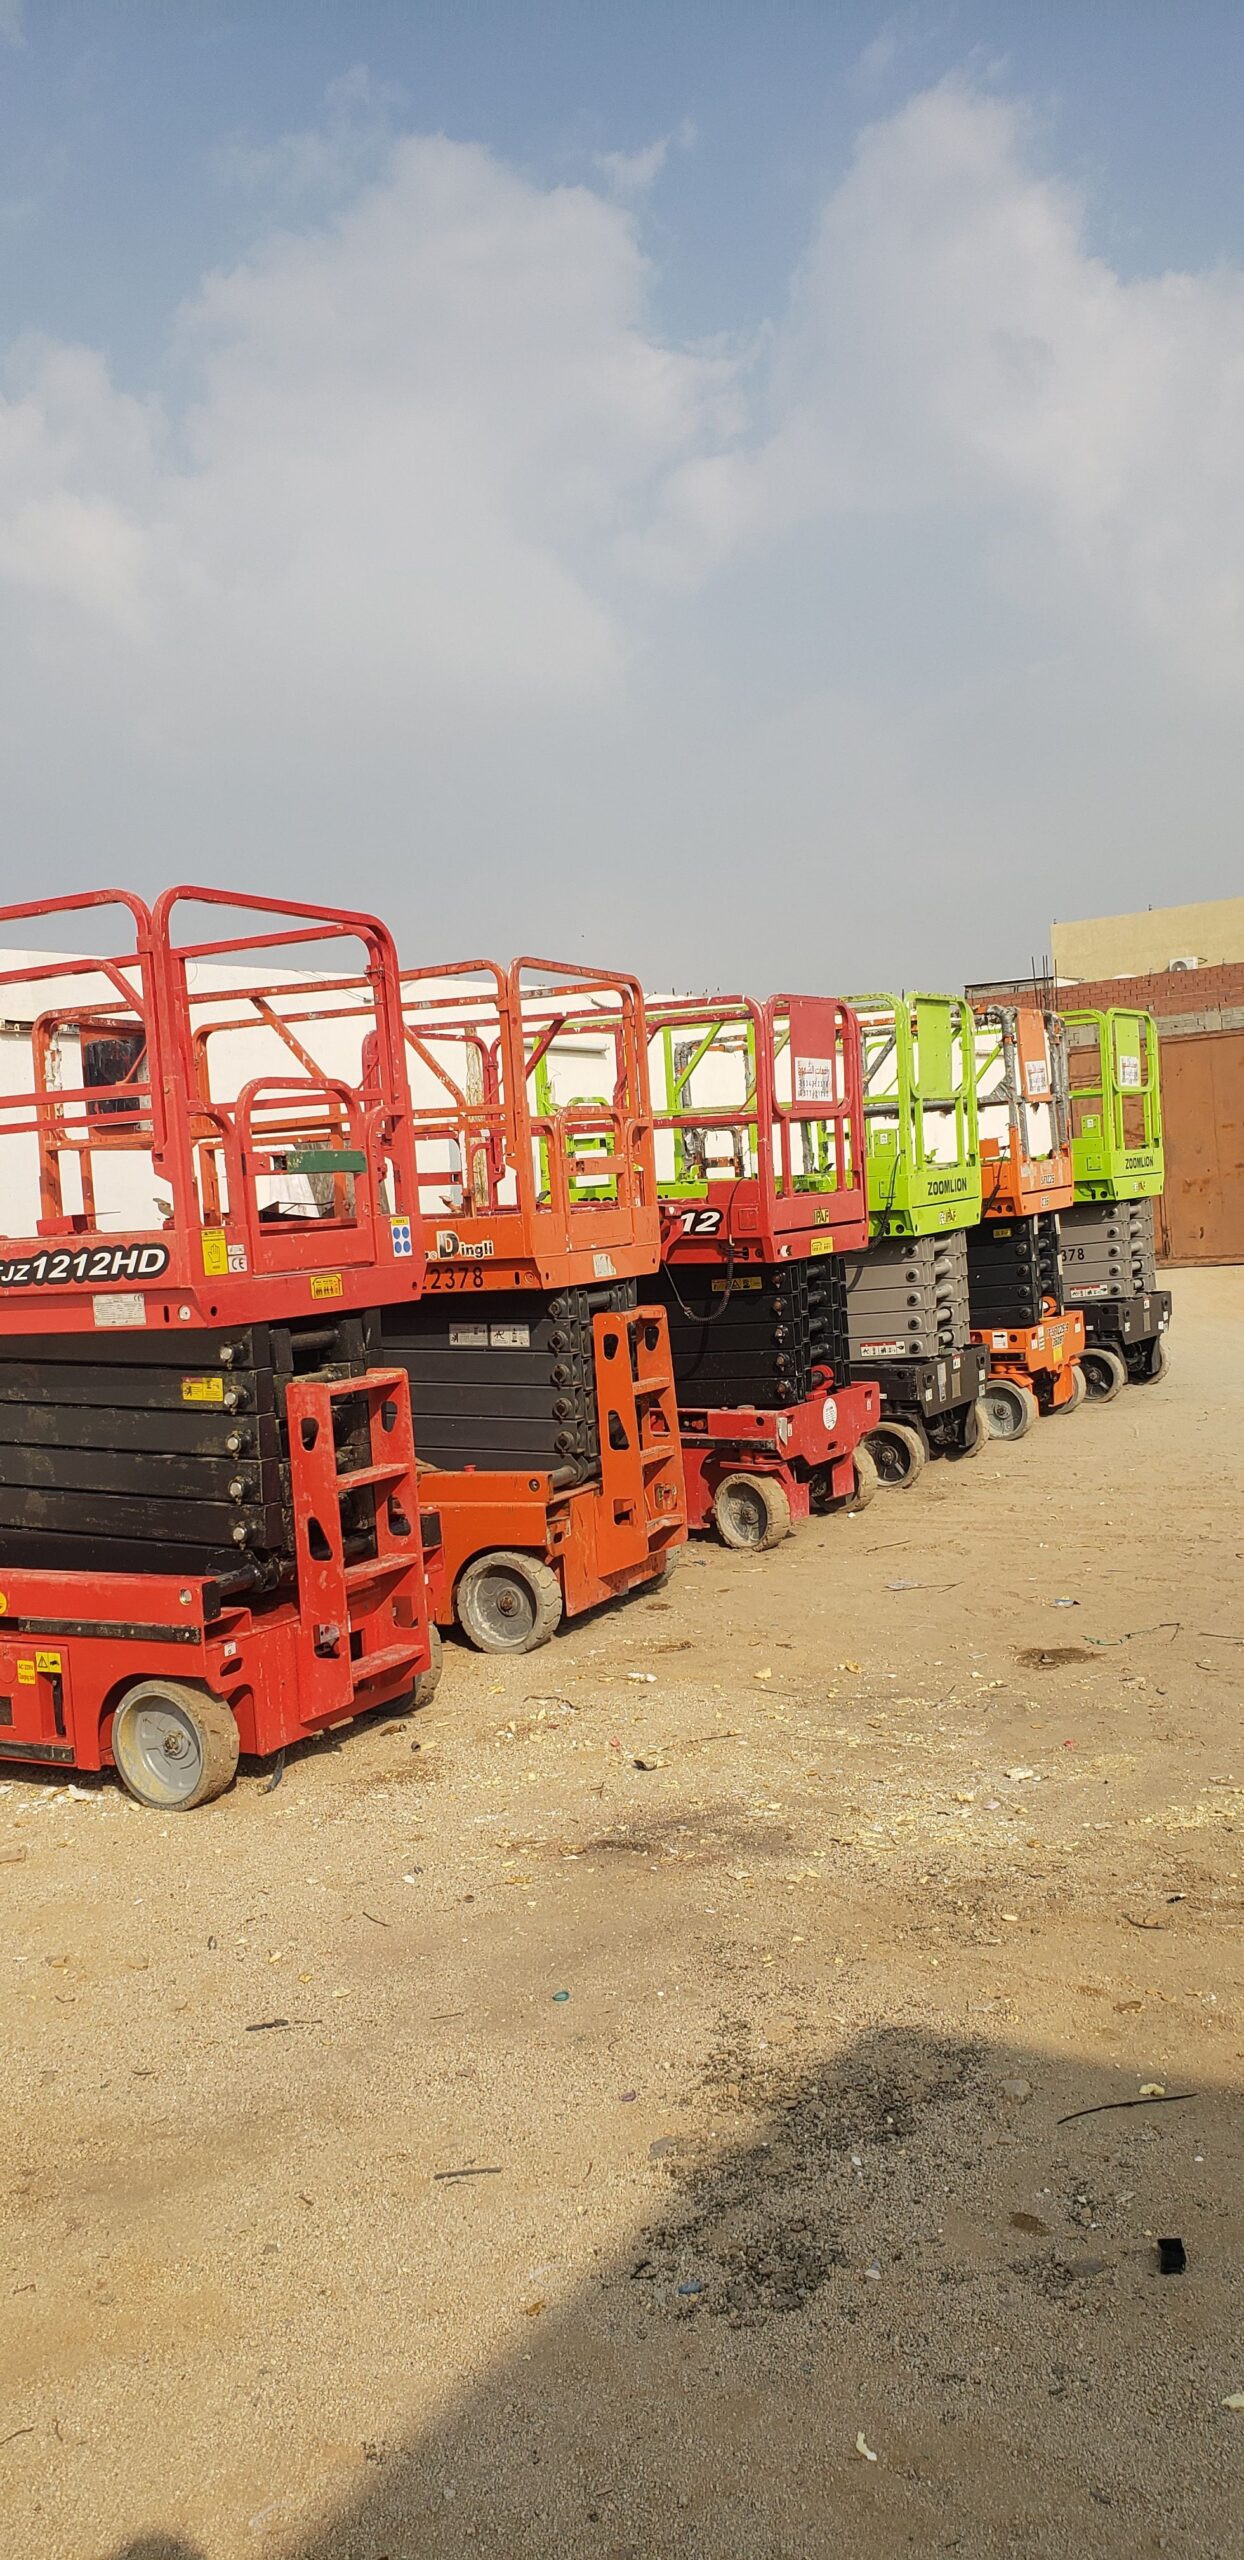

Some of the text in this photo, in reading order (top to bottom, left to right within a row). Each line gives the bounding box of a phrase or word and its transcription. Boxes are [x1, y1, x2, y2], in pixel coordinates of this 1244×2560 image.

[1125, 1156, 1153, 1169] ZOOMLION
[928, 1177, 967, 1196] ZOOMLION
[681, 1212, 720, 1232] 12
[437, 1230, 493, 1258] Dingli
[0, 1249, 165, 1282] JZ1212HD
[231, 1258, 244, 1270] CE
[422, 1267, 483, 1290] 2378
